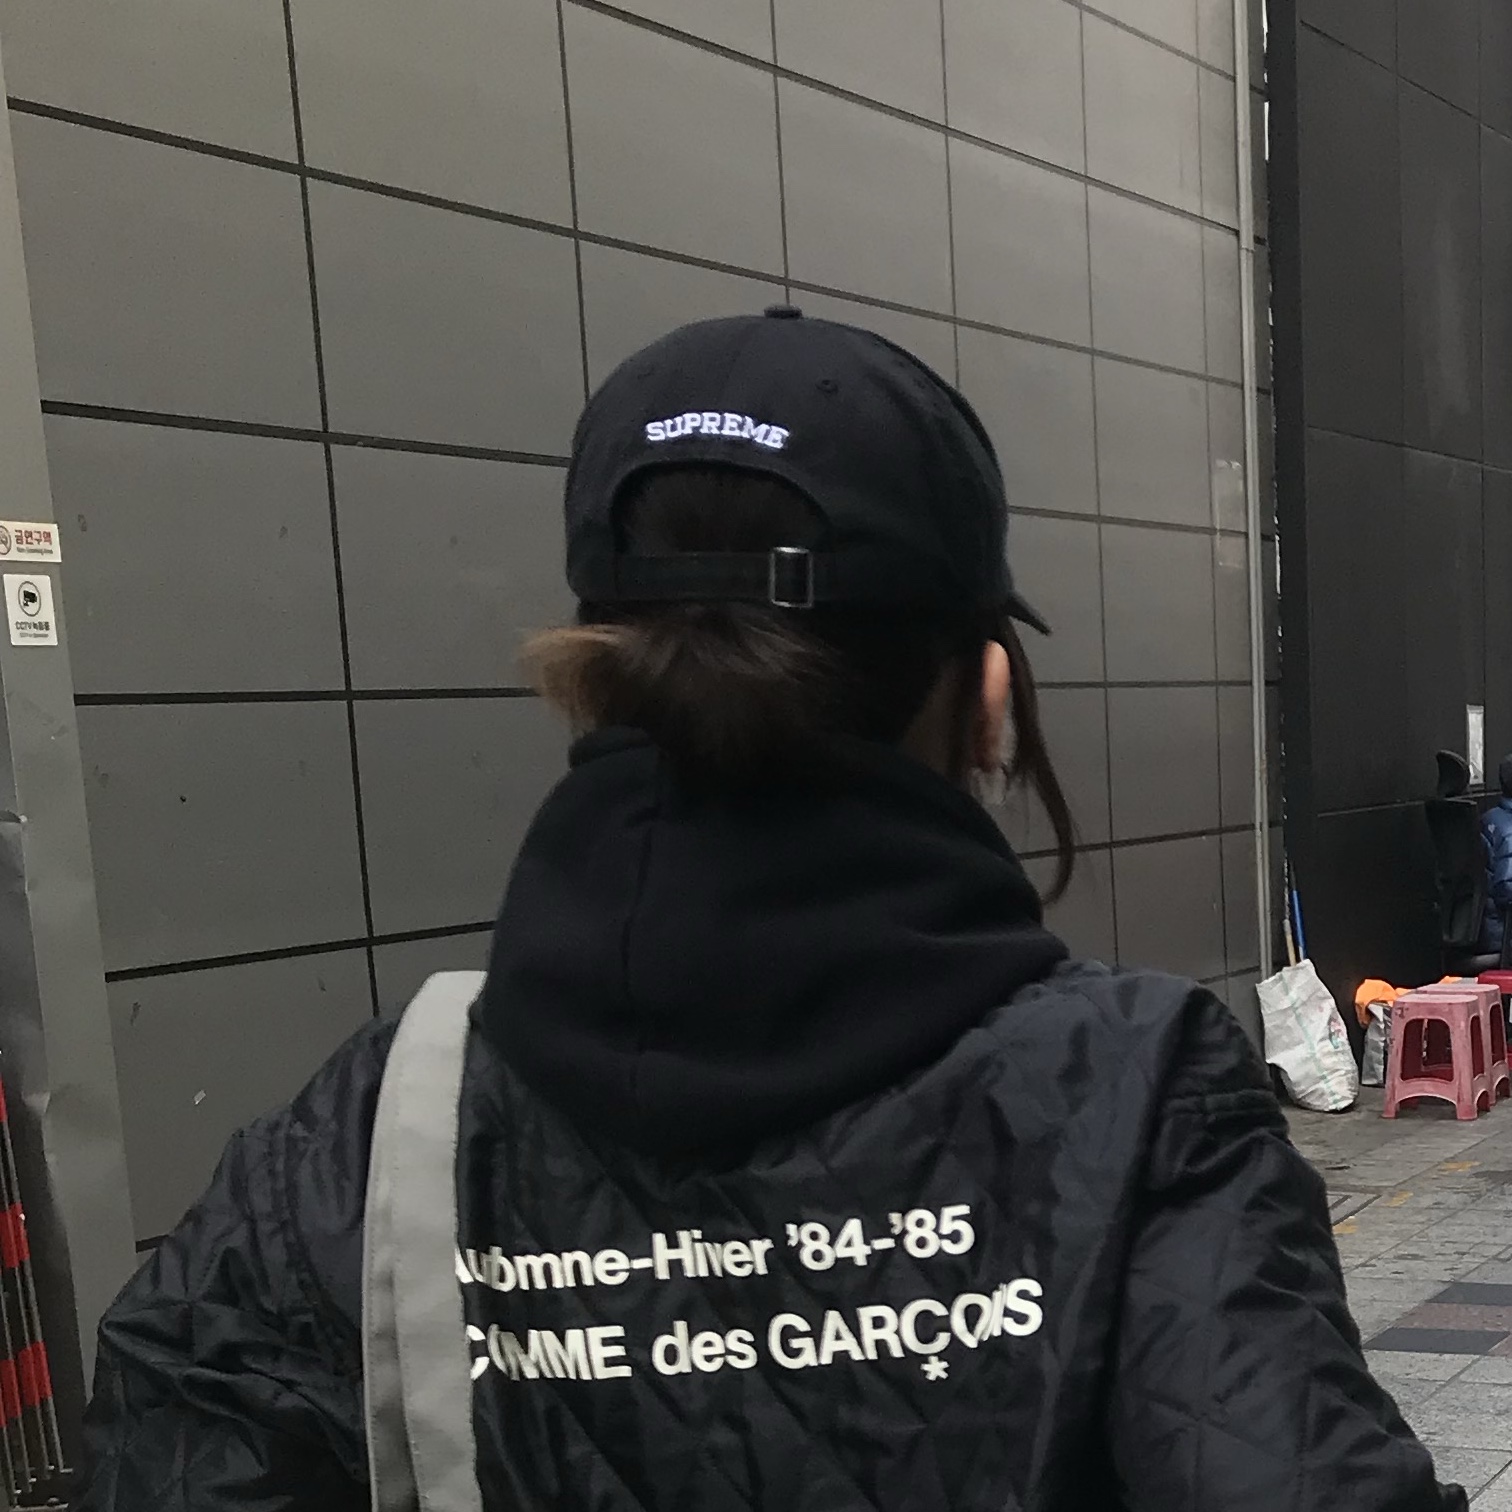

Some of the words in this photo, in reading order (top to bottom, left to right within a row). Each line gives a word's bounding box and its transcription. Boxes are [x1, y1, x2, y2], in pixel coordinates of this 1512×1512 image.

[645, 411, 790, 449] SUPREME
[14, 529, 52, 546] 금연구역
[651, 1320, 757, 1377] des
